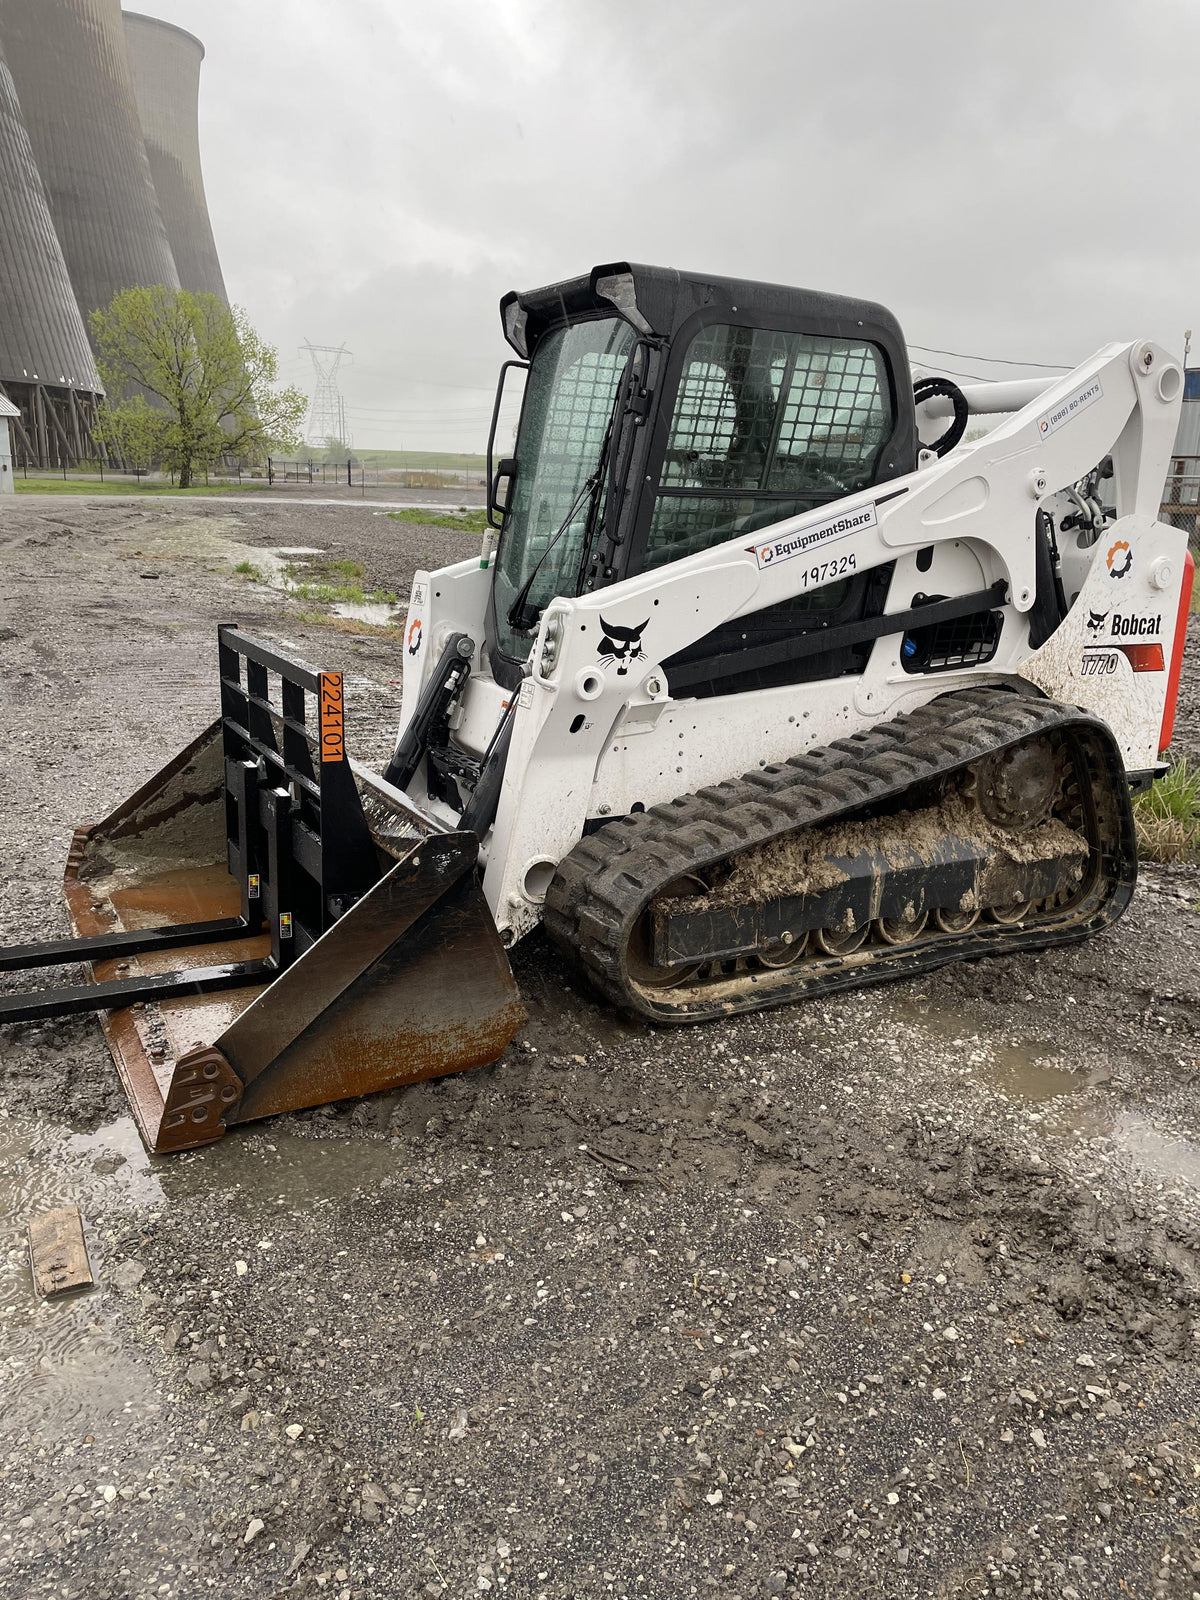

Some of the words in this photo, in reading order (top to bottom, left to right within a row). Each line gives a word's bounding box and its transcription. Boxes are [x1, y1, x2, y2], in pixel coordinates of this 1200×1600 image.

[1050, 407, 1069, 425] (888)
[774, 511, 872, 557] EquipmentShare
[801, 553, 857, 587] 197329
[1111, 614, 1162, 636] Bobcat
[1081, 653, 1119, 676] T770
[322, 675, 342, 757] 224101
